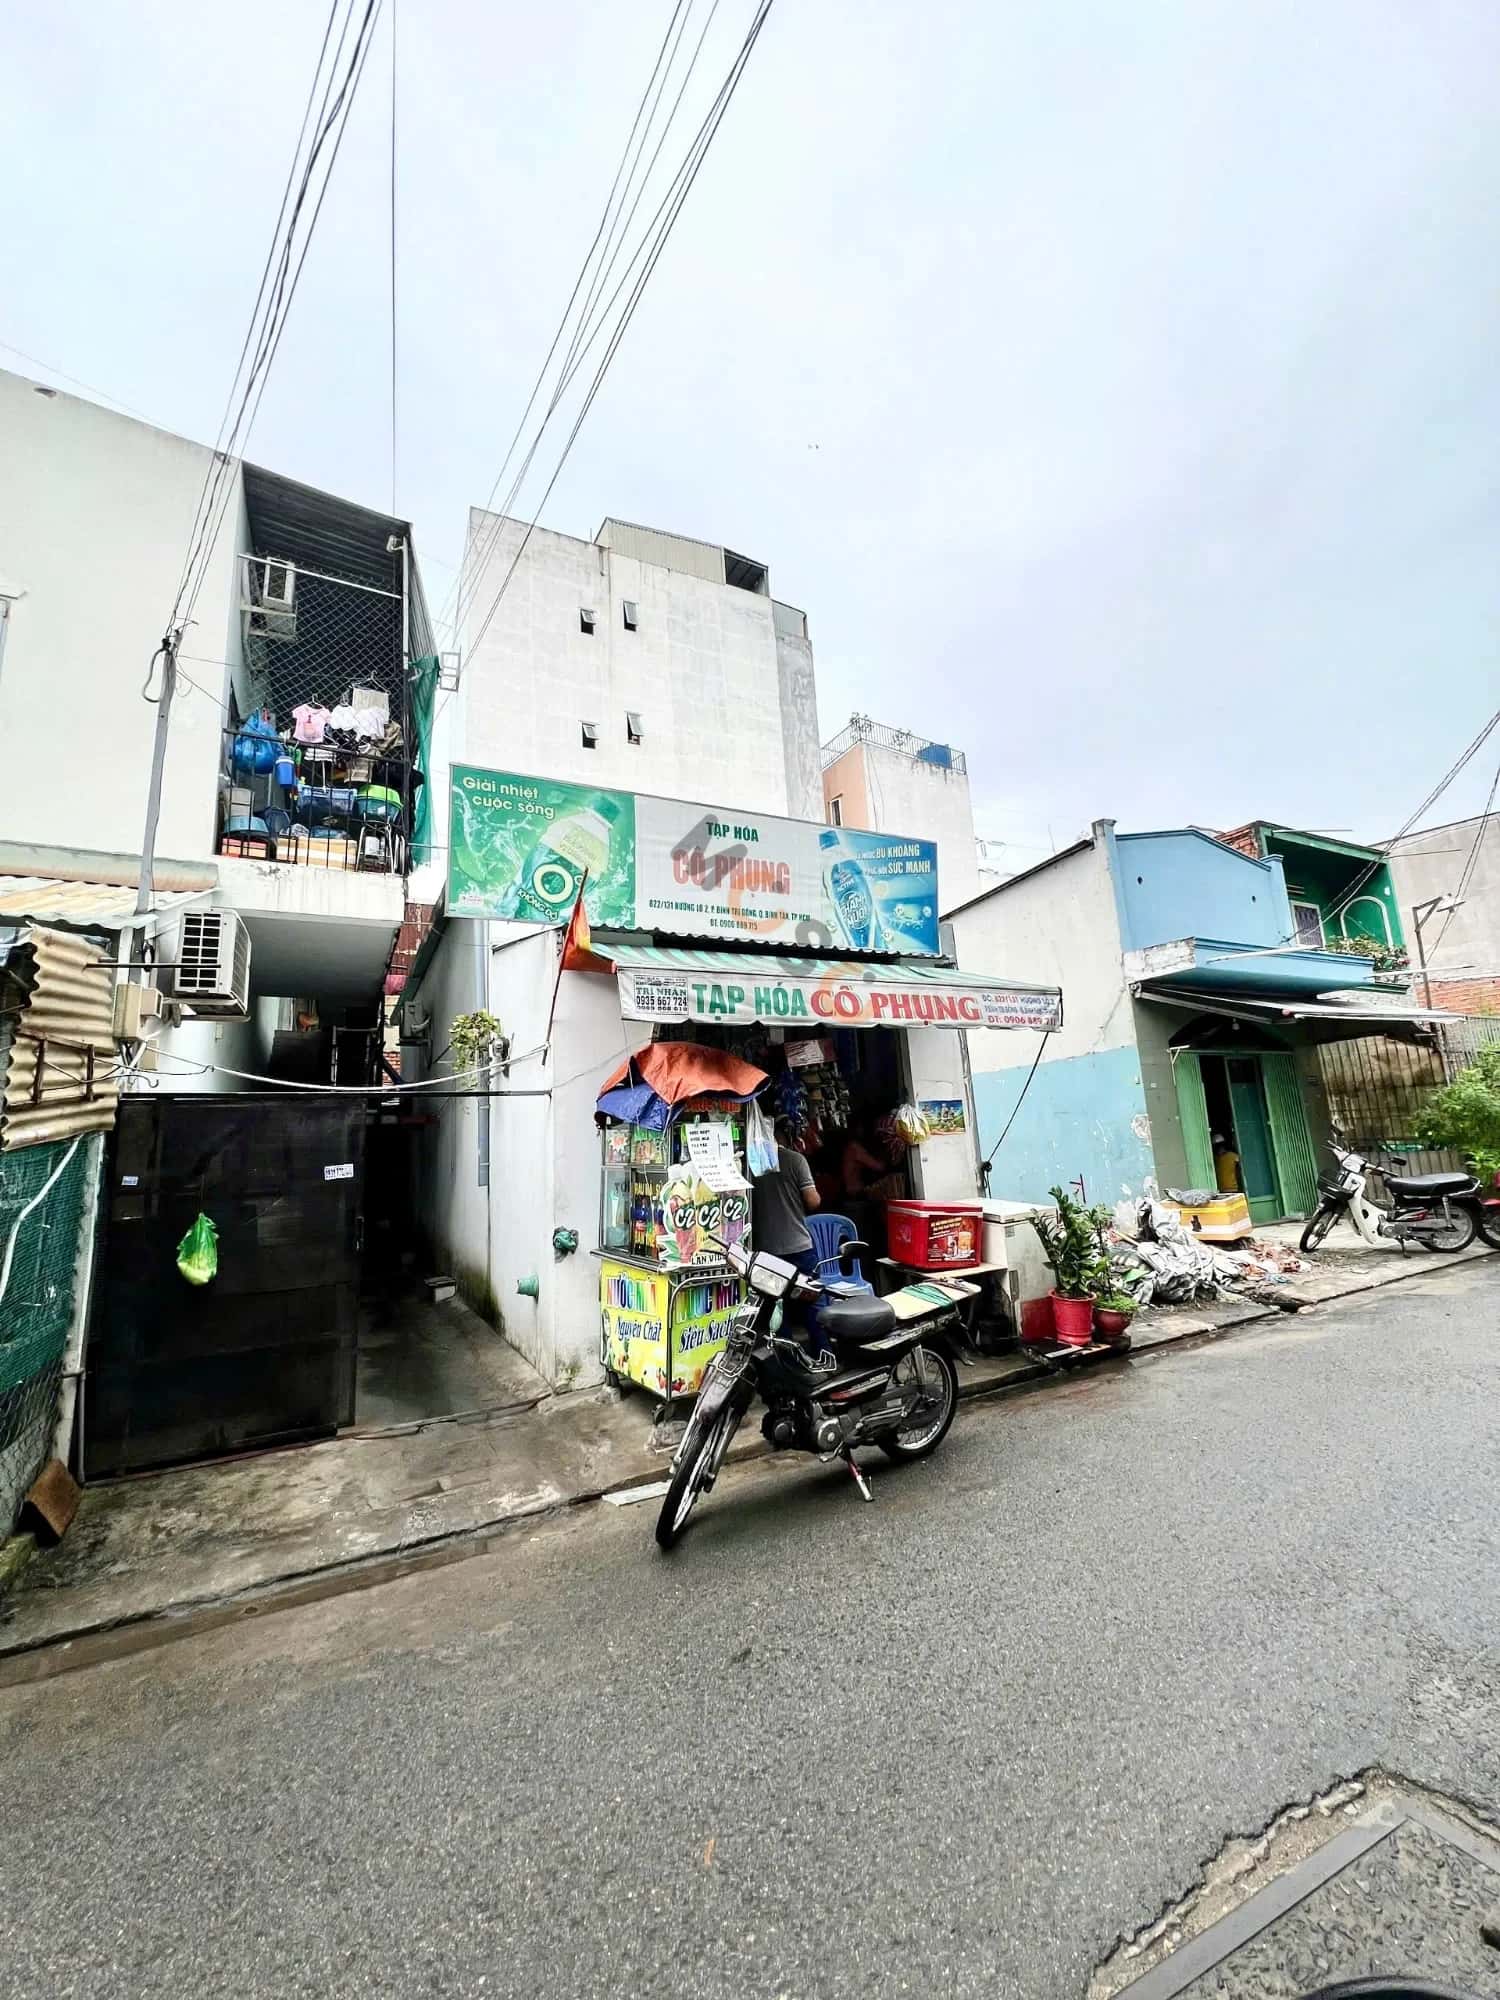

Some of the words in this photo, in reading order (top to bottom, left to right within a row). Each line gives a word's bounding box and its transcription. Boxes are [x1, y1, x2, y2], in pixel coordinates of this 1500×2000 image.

[463, 776, 496, 793] Giải
[499, 783, 539, 799] nhiệt
[472, 794, 513, 810] cuộc
[517, 799, 555, 820] sống
[705, 821, 730, 840] TẠP
[733, 825, 759, 843] HÓA
[672, 845, 706, 886] CÔ
[713, 854, 791, 898] PHỤNG
[692, 983, 745, 1021] TẠP
[753, 982, 808, 1017] HÓA
[811, 985, 862, 1018] CÔ
[869, 992, 981, 1026] PHỤNG
[675, 1208, 696, 1229] C2
[698, 1204, 720, 1230] C2
[723, 1198, 743, 1221] C2
[643, 1317, 662, 1342] Chất
